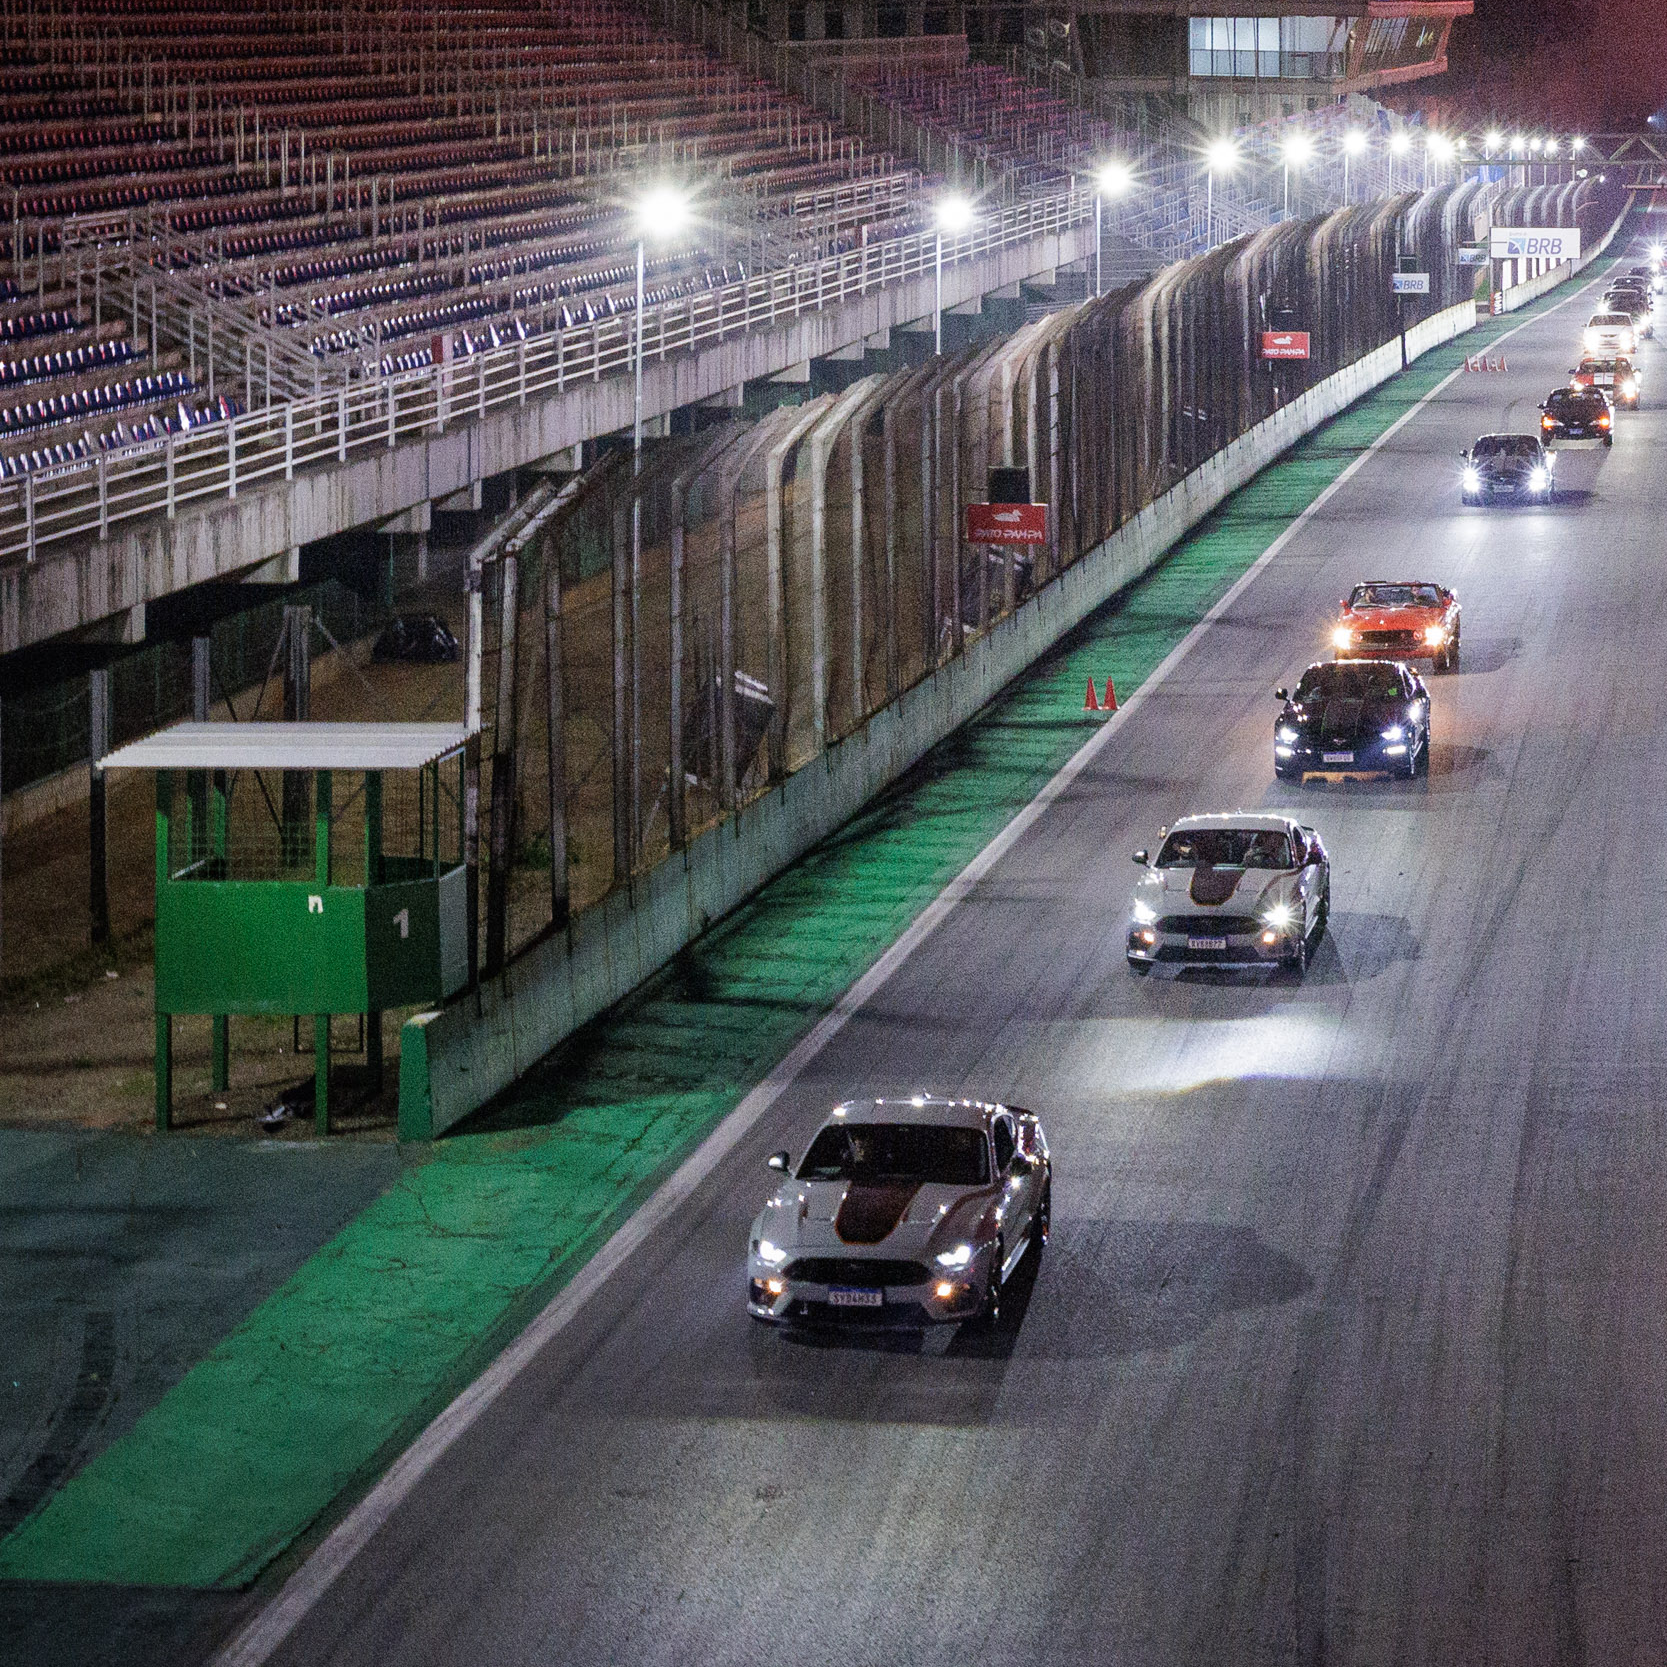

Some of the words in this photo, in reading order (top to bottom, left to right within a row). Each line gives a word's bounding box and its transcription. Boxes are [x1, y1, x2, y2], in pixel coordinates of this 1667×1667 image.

[1526, 238, 1562, 255] BRB
[1468, 254, 1486, 263] BRB
[1402, 280, 1423, 290] BRB
[1003, 529, 1043, 539] PAMPA
[393, 908, 409, 939] 1
